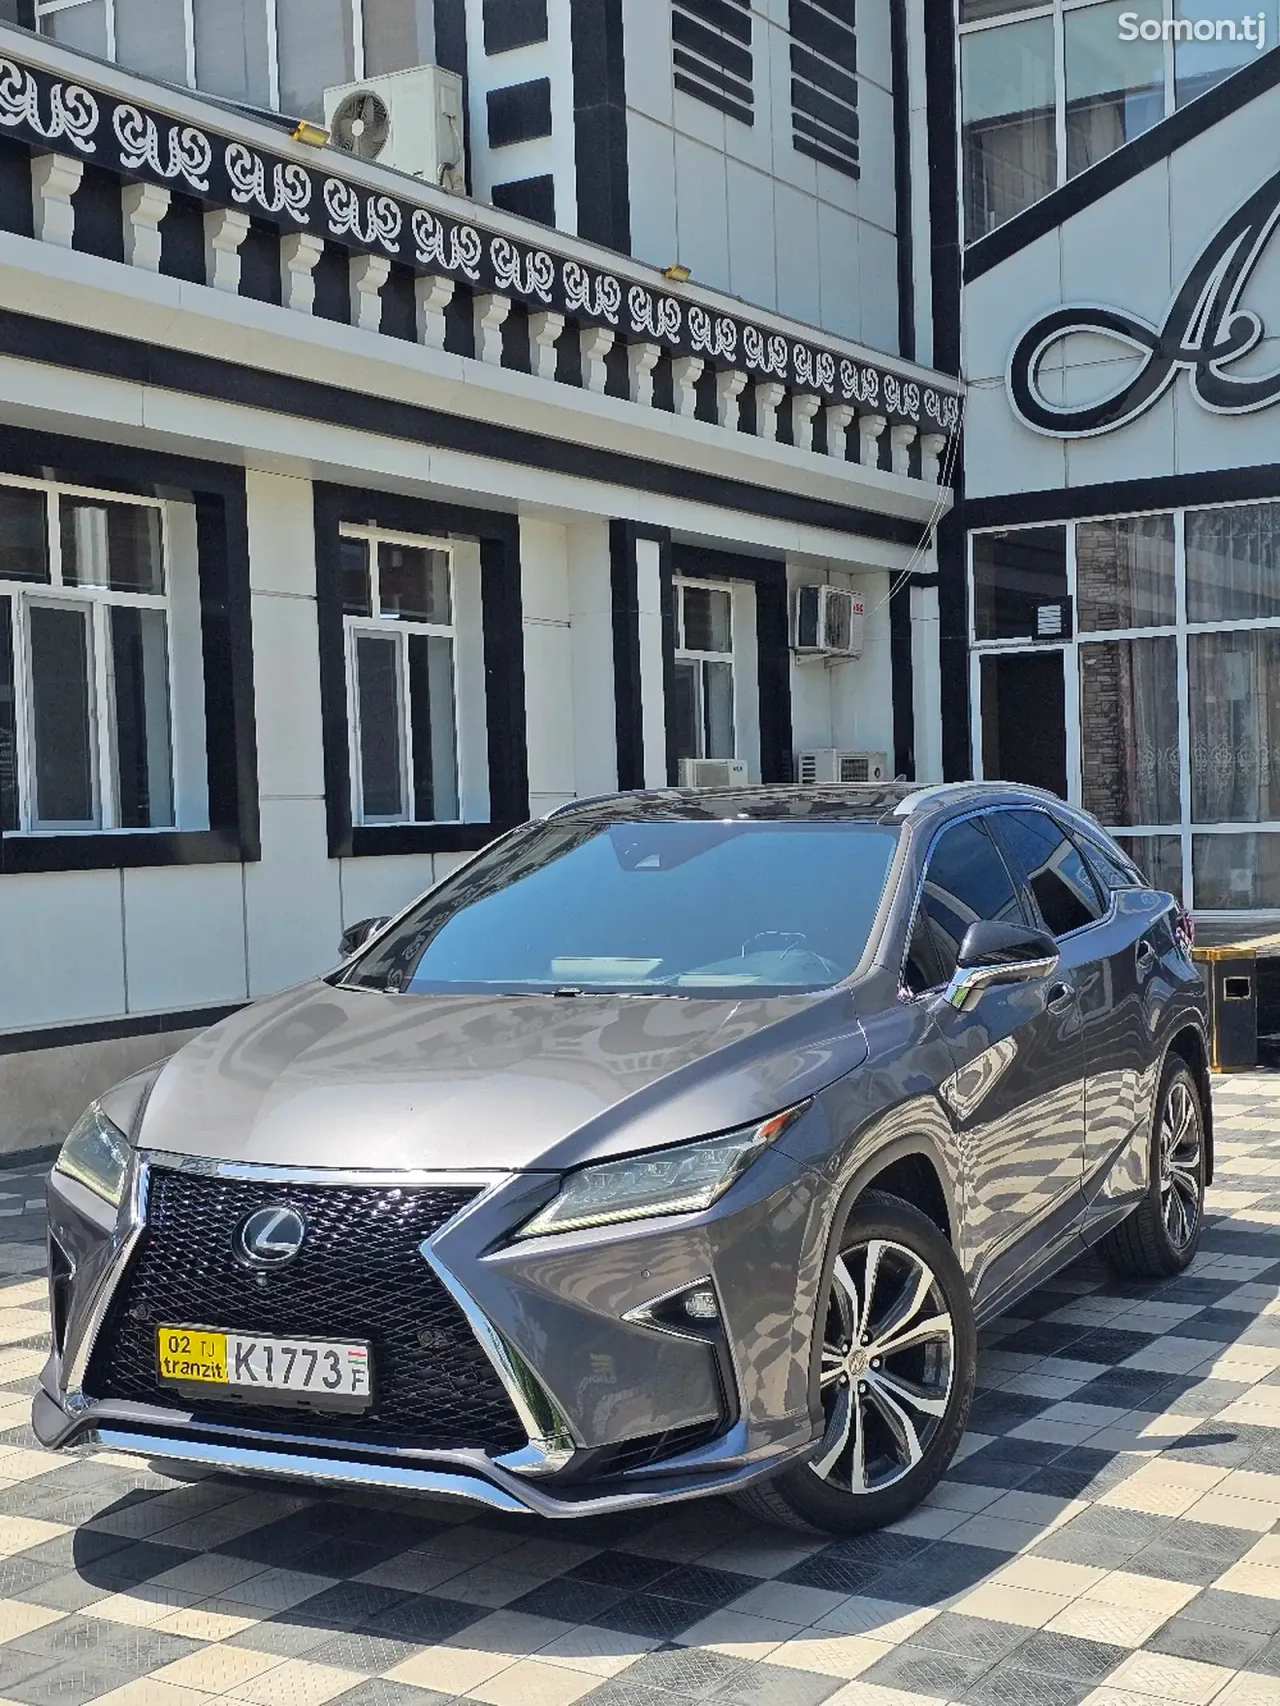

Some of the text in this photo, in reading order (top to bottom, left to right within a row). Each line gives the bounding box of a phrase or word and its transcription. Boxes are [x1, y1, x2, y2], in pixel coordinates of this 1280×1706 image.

[168, 1335, 192, 1354] 02
[163, 1356, 223, 1379] tranzit
[234, 1342, 342, 1389] K1773
[351, 1368, 365, 1391] F
